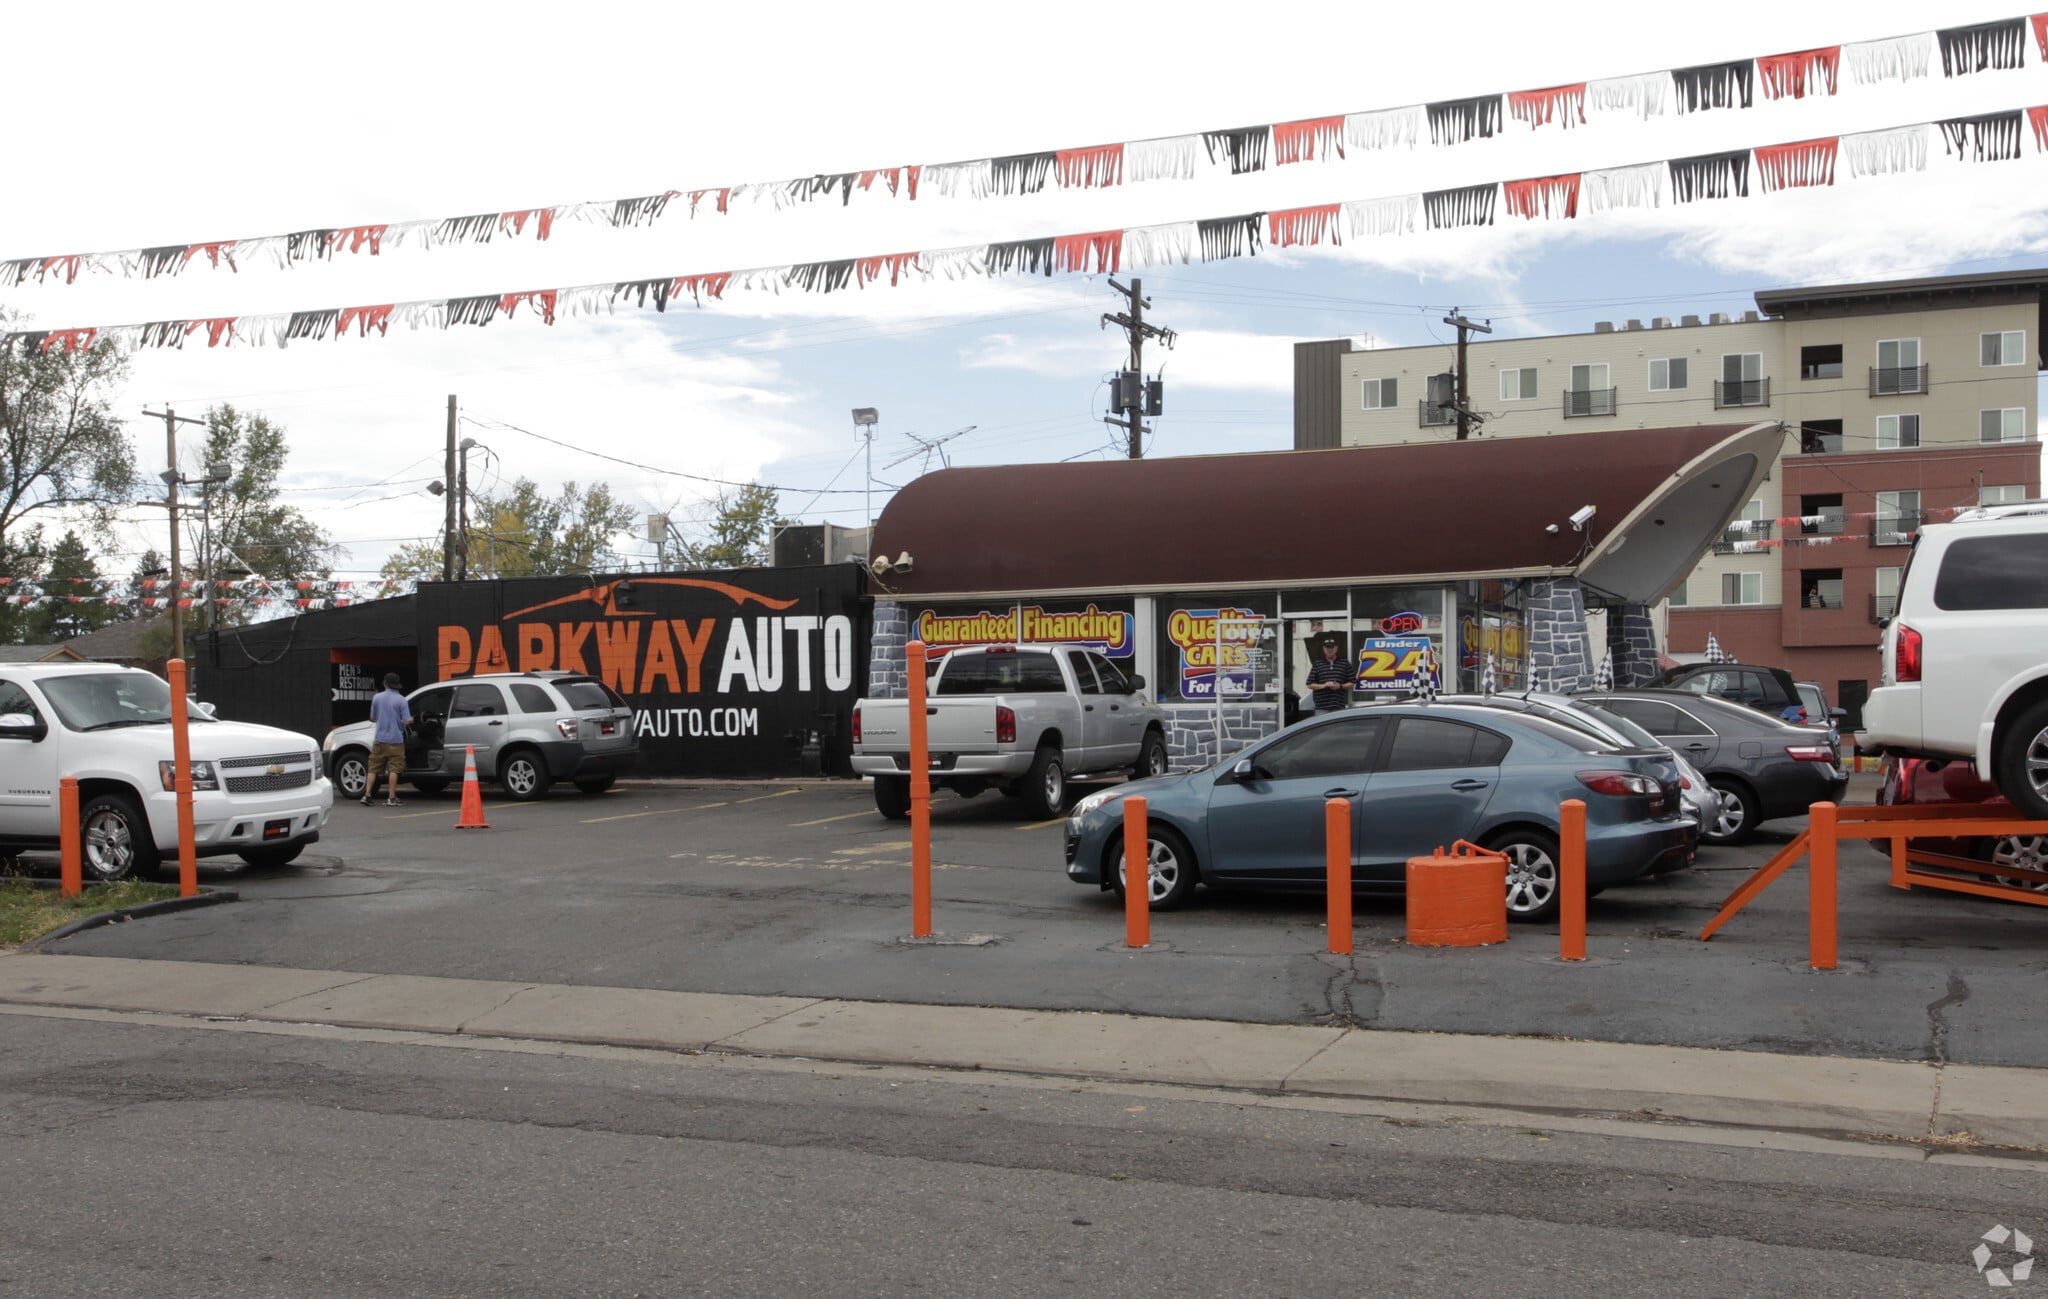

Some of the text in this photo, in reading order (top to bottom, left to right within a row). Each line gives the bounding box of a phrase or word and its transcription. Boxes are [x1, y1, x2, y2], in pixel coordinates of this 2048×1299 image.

[920, 604, 1125, 645] Guaranteed Financing
[1381, 616, 1423, 632] OPEN
[1374, 640, 1421, 648] Under
[437, 615, 852, 695] PARKWAY AUTO
[1186, 645, 1249, 665] CARS
[1359, 650, 1437, 677] 24
[1188, 679, 1212, 694] For
